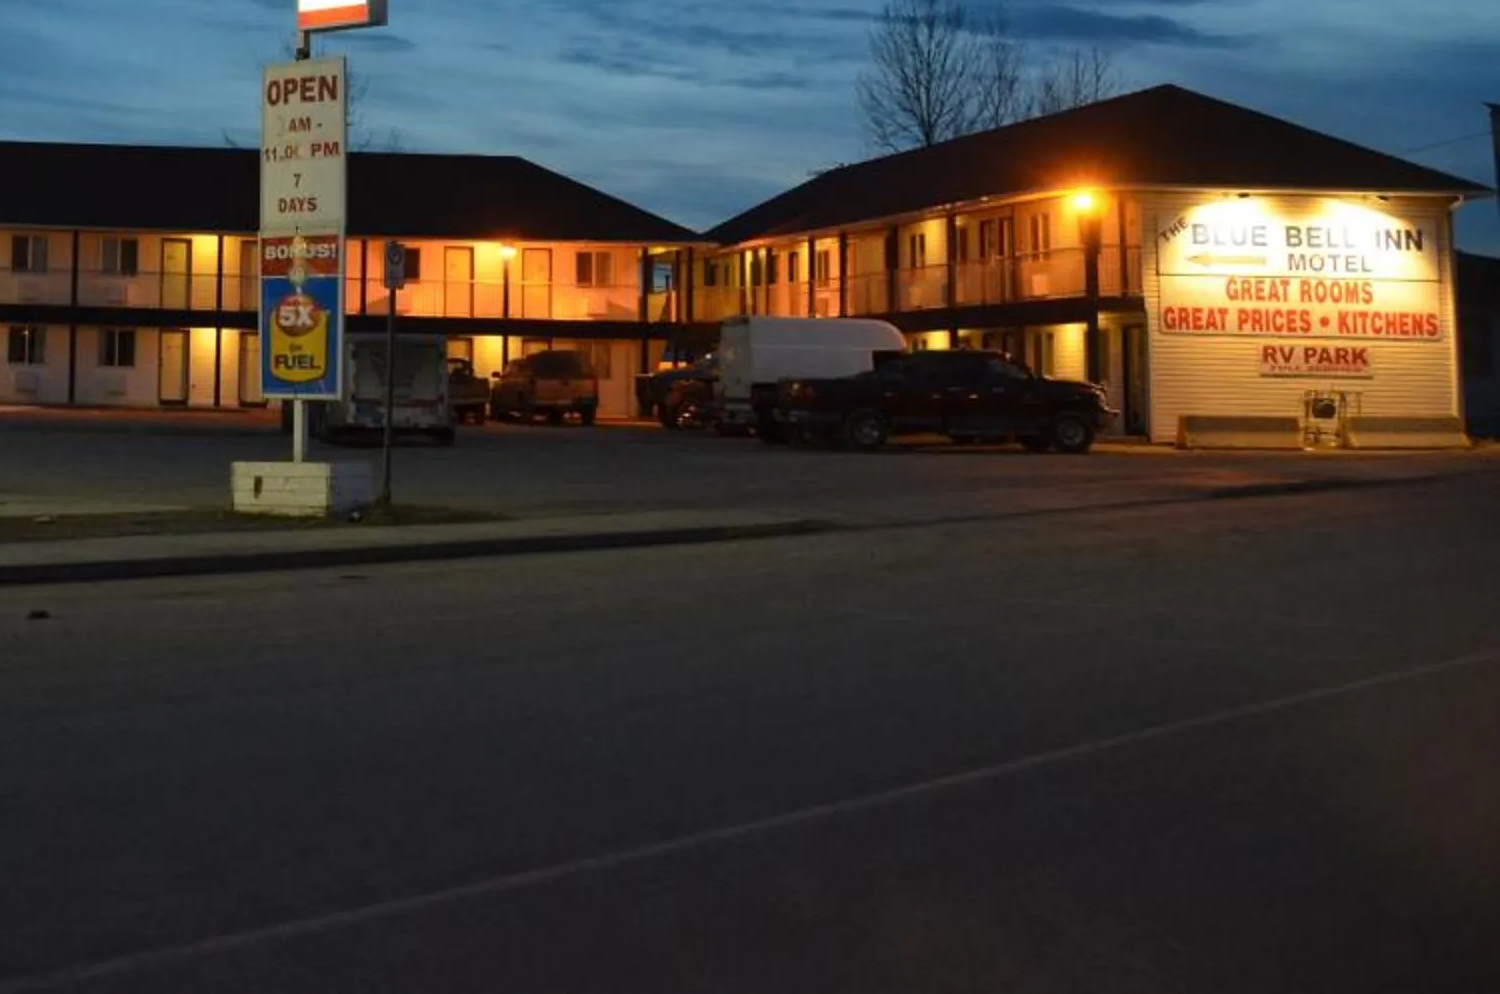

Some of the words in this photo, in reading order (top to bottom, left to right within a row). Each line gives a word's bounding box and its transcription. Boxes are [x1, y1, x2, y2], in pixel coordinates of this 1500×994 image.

[266, 75, 338, 107] OPEN
[289, 116, 311, 133] AM
[311, 142, 340, 157] PM
[293, 173, 301, 188] 7
[278, 197, 318, 213] DAYS
[1160, 217, 1188, 242] THE
[1191, 223, 1268, 247] BLUE
[1285, 225, 1357, 249] BELL
[1376, 228, 1424, 252] INN
[1287, 254, 1373, 273] MOTEL
[1225, 276, 1291, 302] GREAT
[1299, 278, 1374, 305] ROOMS
[279, 305, 315, 327] 5X
[1163, 306, 1229, 331] GREAT
[1237, 308, 1312, 334] PRICES
[1338, 310, 1439, 337] KITCHENS
[274, 354, 322, 371] FUEL
[1262, 345, 1296, 364] RV
[1303, 347, 1369, 366] PARK
